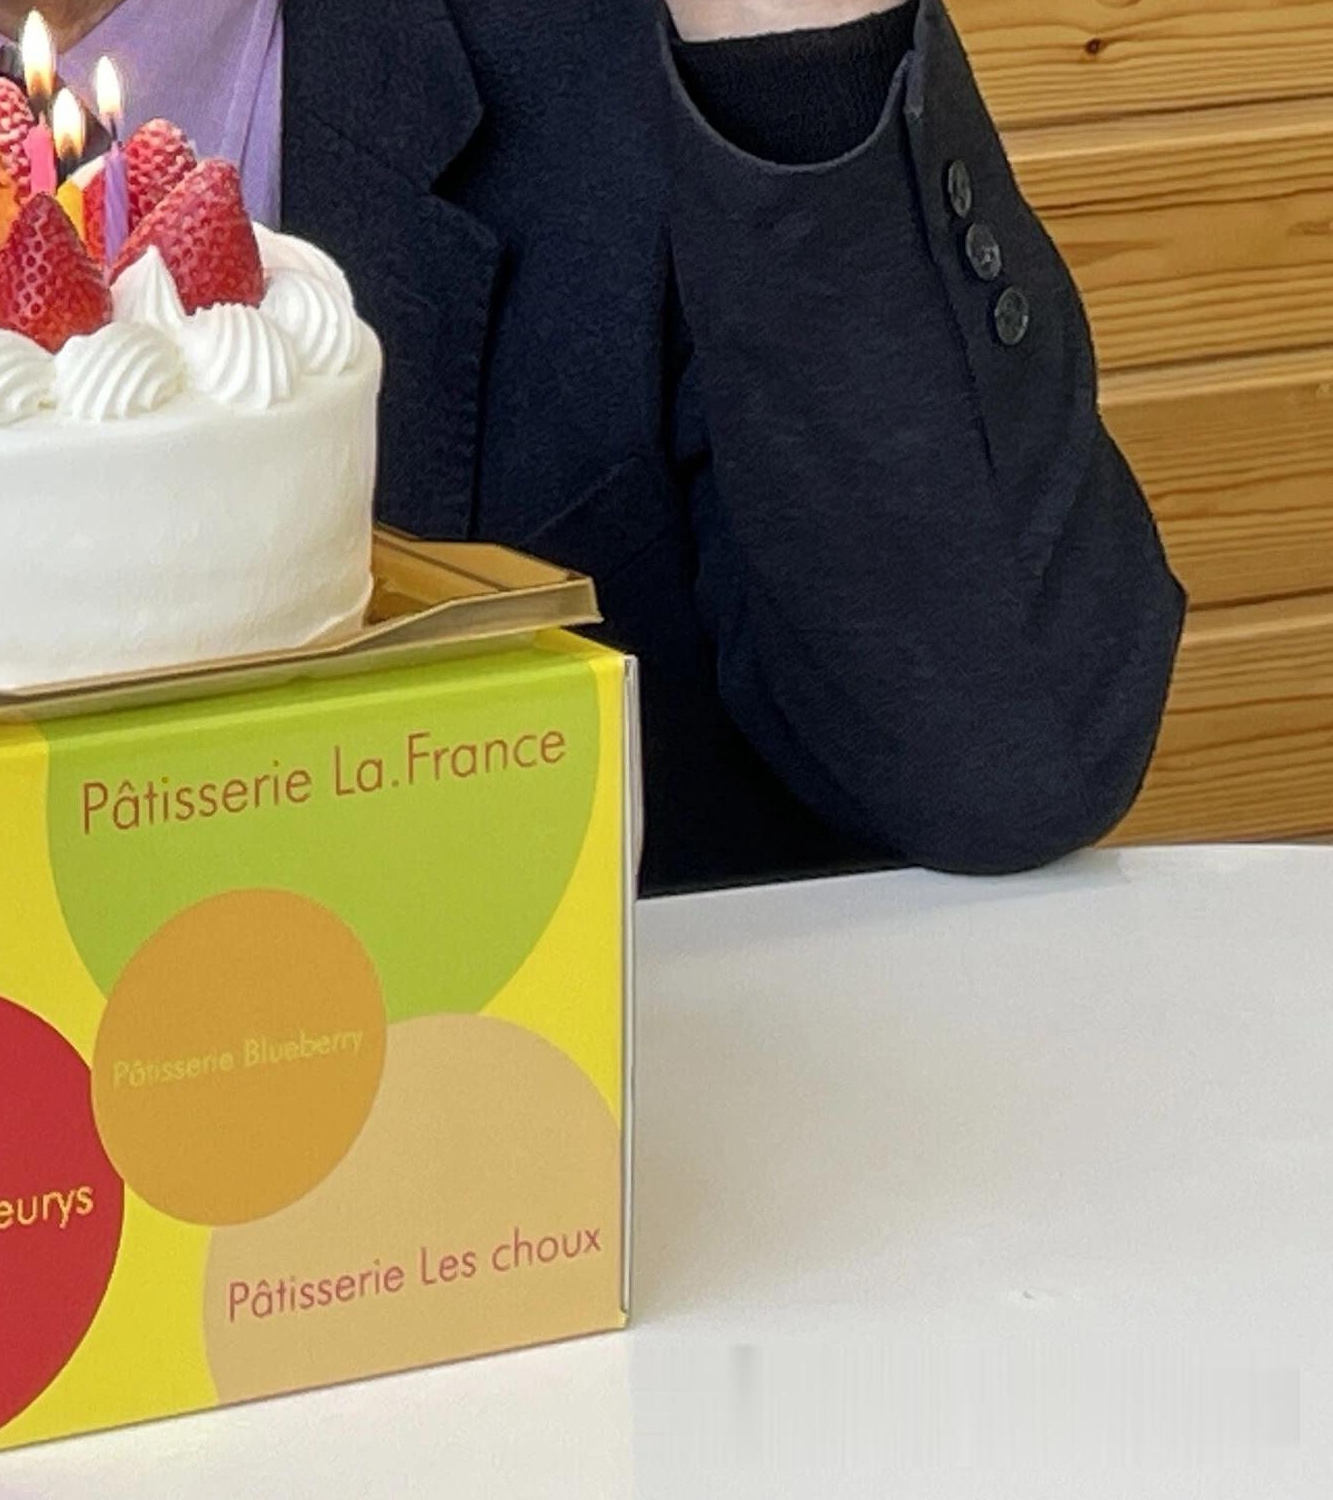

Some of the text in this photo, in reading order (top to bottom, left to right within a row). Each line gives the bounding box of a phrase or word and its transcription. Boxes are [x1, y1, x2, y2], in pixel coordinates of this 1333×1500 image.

[81, 758, 313, 835] Pâtisserie
[243, 1027, 365, 1069] Blueberry
[228, 1226, 603, 1324] Pâtisserie Les choux
